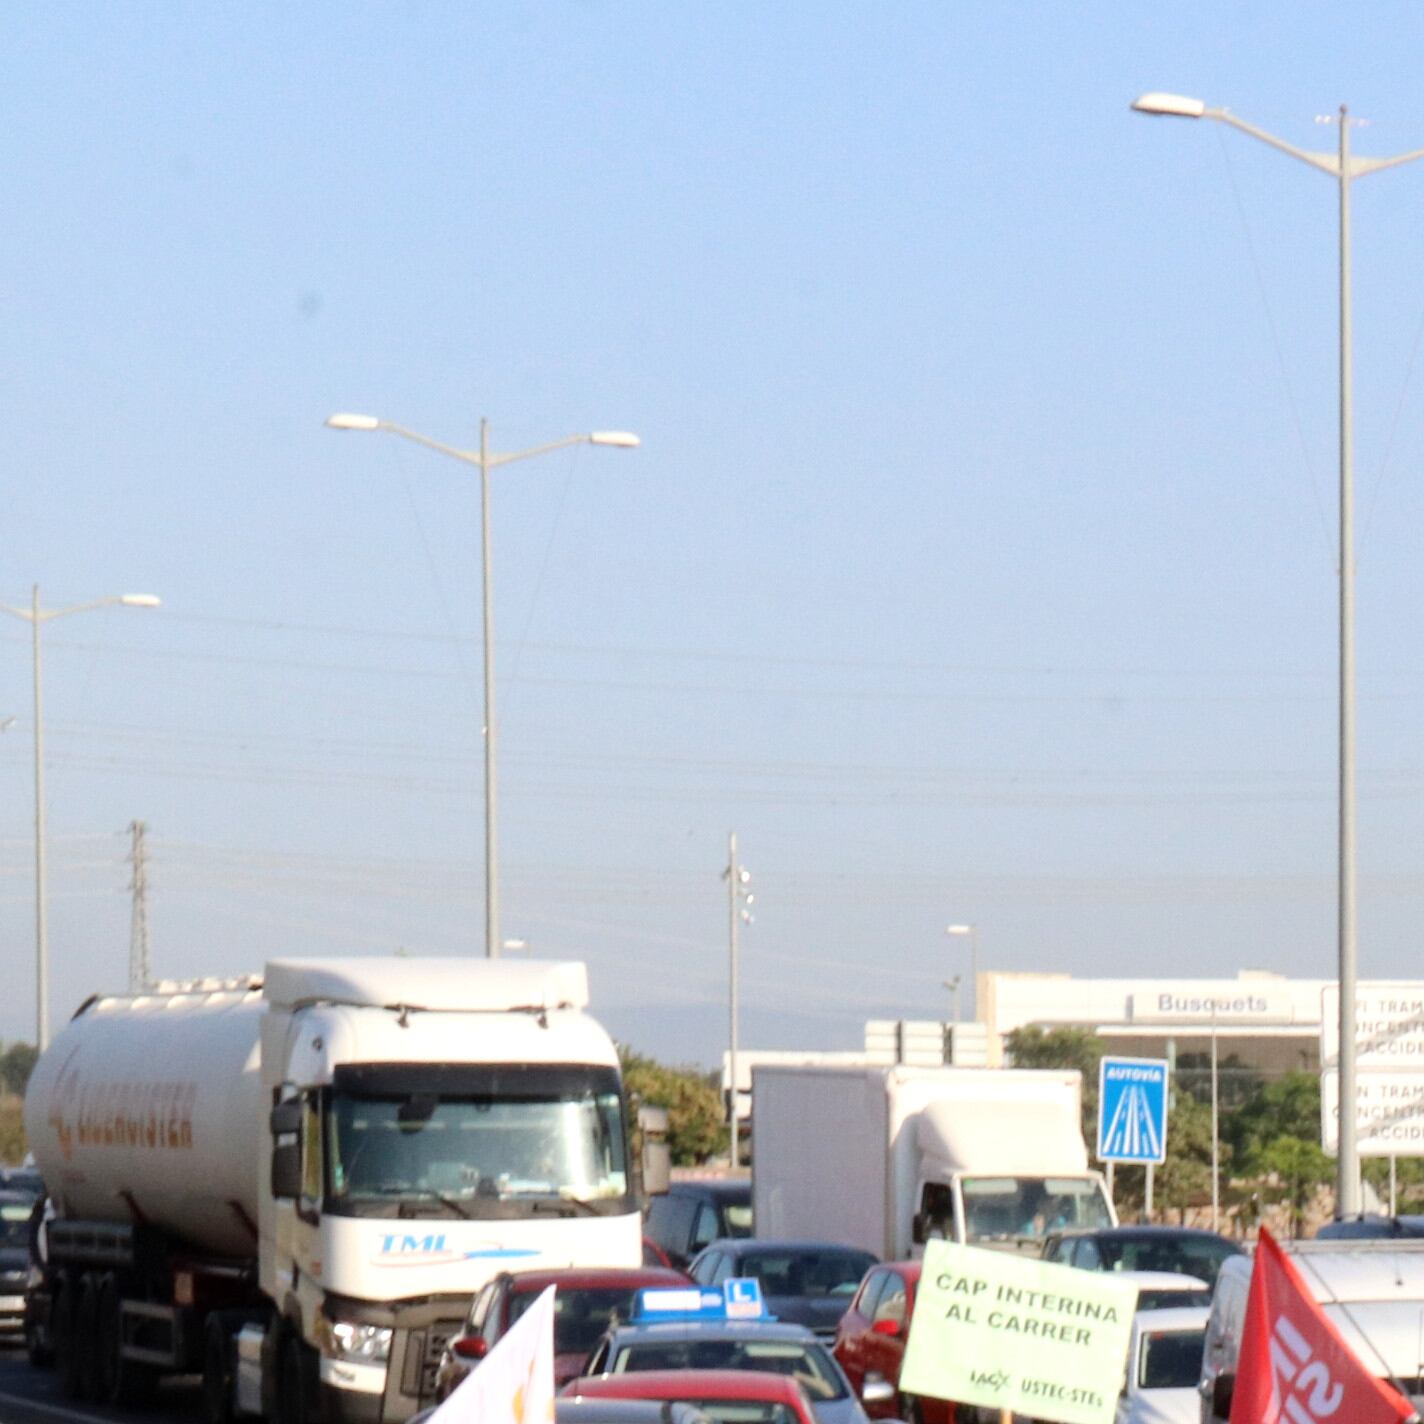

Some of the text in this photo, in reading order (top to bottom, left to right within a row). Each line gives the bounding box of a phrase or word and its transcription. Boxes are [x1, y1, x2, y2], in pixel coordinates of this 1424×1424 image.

[1158, 994, 1267, 1013] Busquets
[1380, 1001, 1423, 1014] TRAM
[1106, 1066, 1163, 1082] AUTOVÍA
[936, 1273, 1118, 1323] CAP INTERINA
[945, 1303, 1091, 1346] AL CARRER
